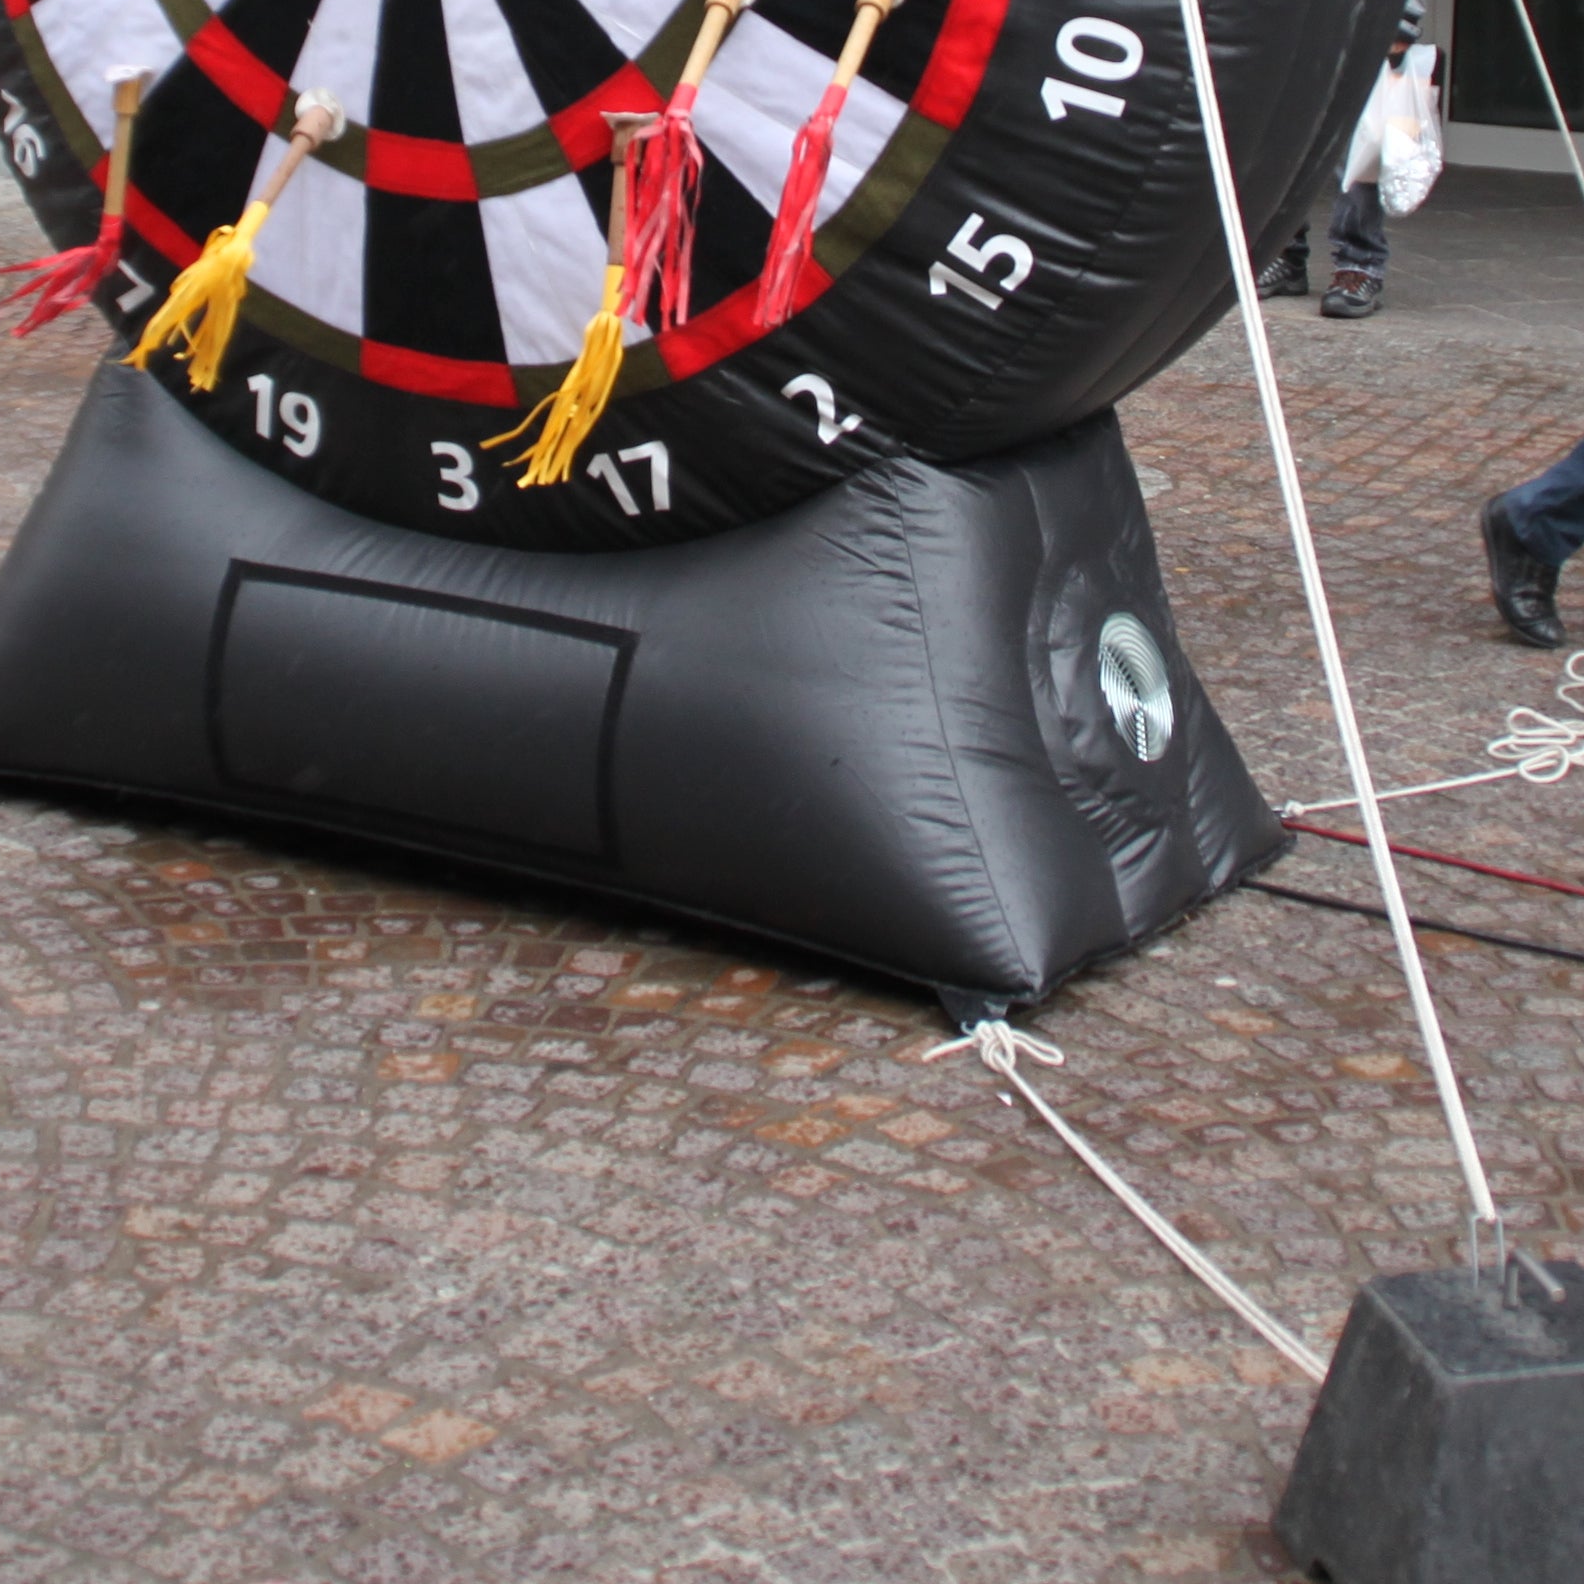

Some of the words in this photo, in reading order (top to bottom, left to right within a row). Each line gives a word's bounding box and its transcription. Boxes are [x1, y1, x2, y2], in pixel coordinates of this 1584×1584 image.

[1040, 16, 1145, 122] 10
[1, 87, 46, 180] 16
[116, 258, 156, 314] 7
[928, 213, 1035, 311] 15
[246, 372, 321, 458] 19
[780, 372, 864, 445] 2
[430, 440, 480, 512] 3
[585, 440, 672, 516] 17
